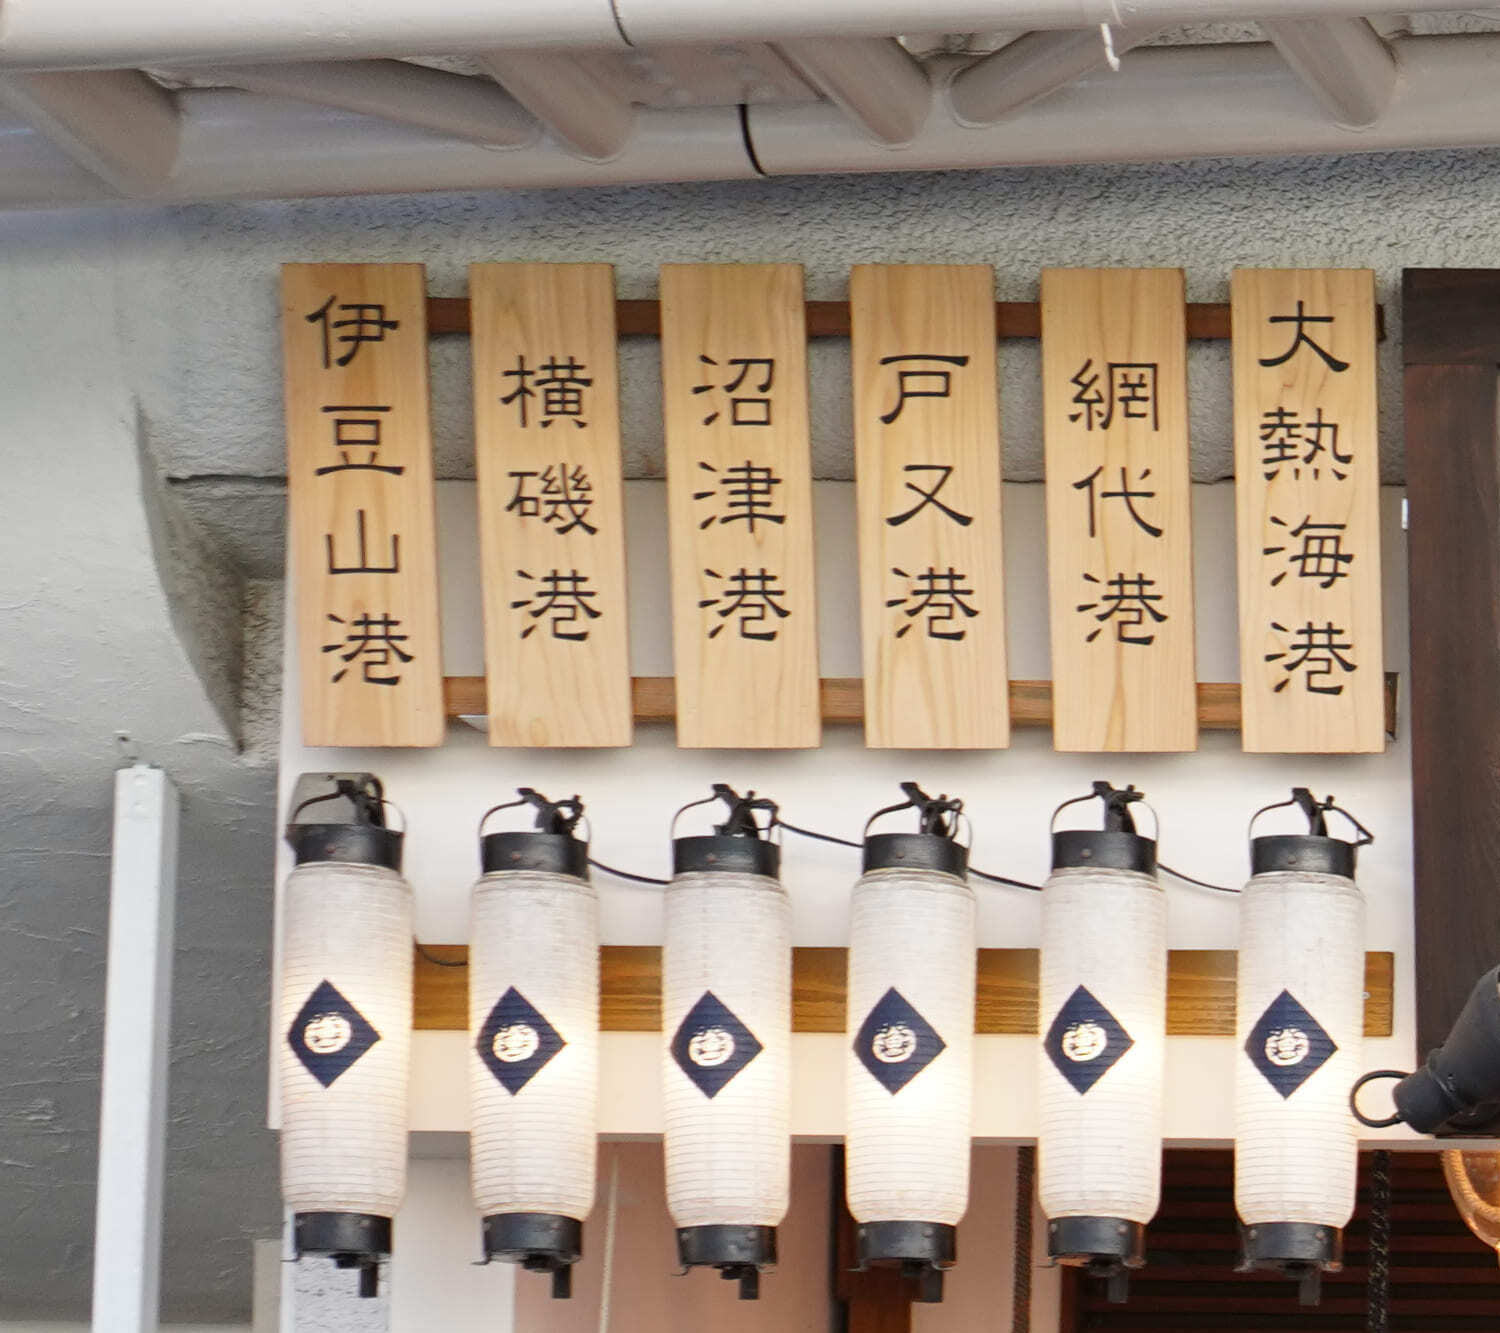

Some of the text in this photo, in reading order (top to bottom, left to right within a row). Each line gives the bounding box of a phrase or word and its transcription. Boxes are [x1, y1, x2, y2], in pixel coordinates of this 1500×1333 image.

[305, 296, 416, 687] 伊豆山港
[502, 355, 603, 643] 横磯港
[693, 354, 792, 643] 沼津港
[879, 354, 982, 643] 戸又港
[1068, 359, 1169, 647] 網代港
[1258, 302, 1358, 696] 大熱海港
